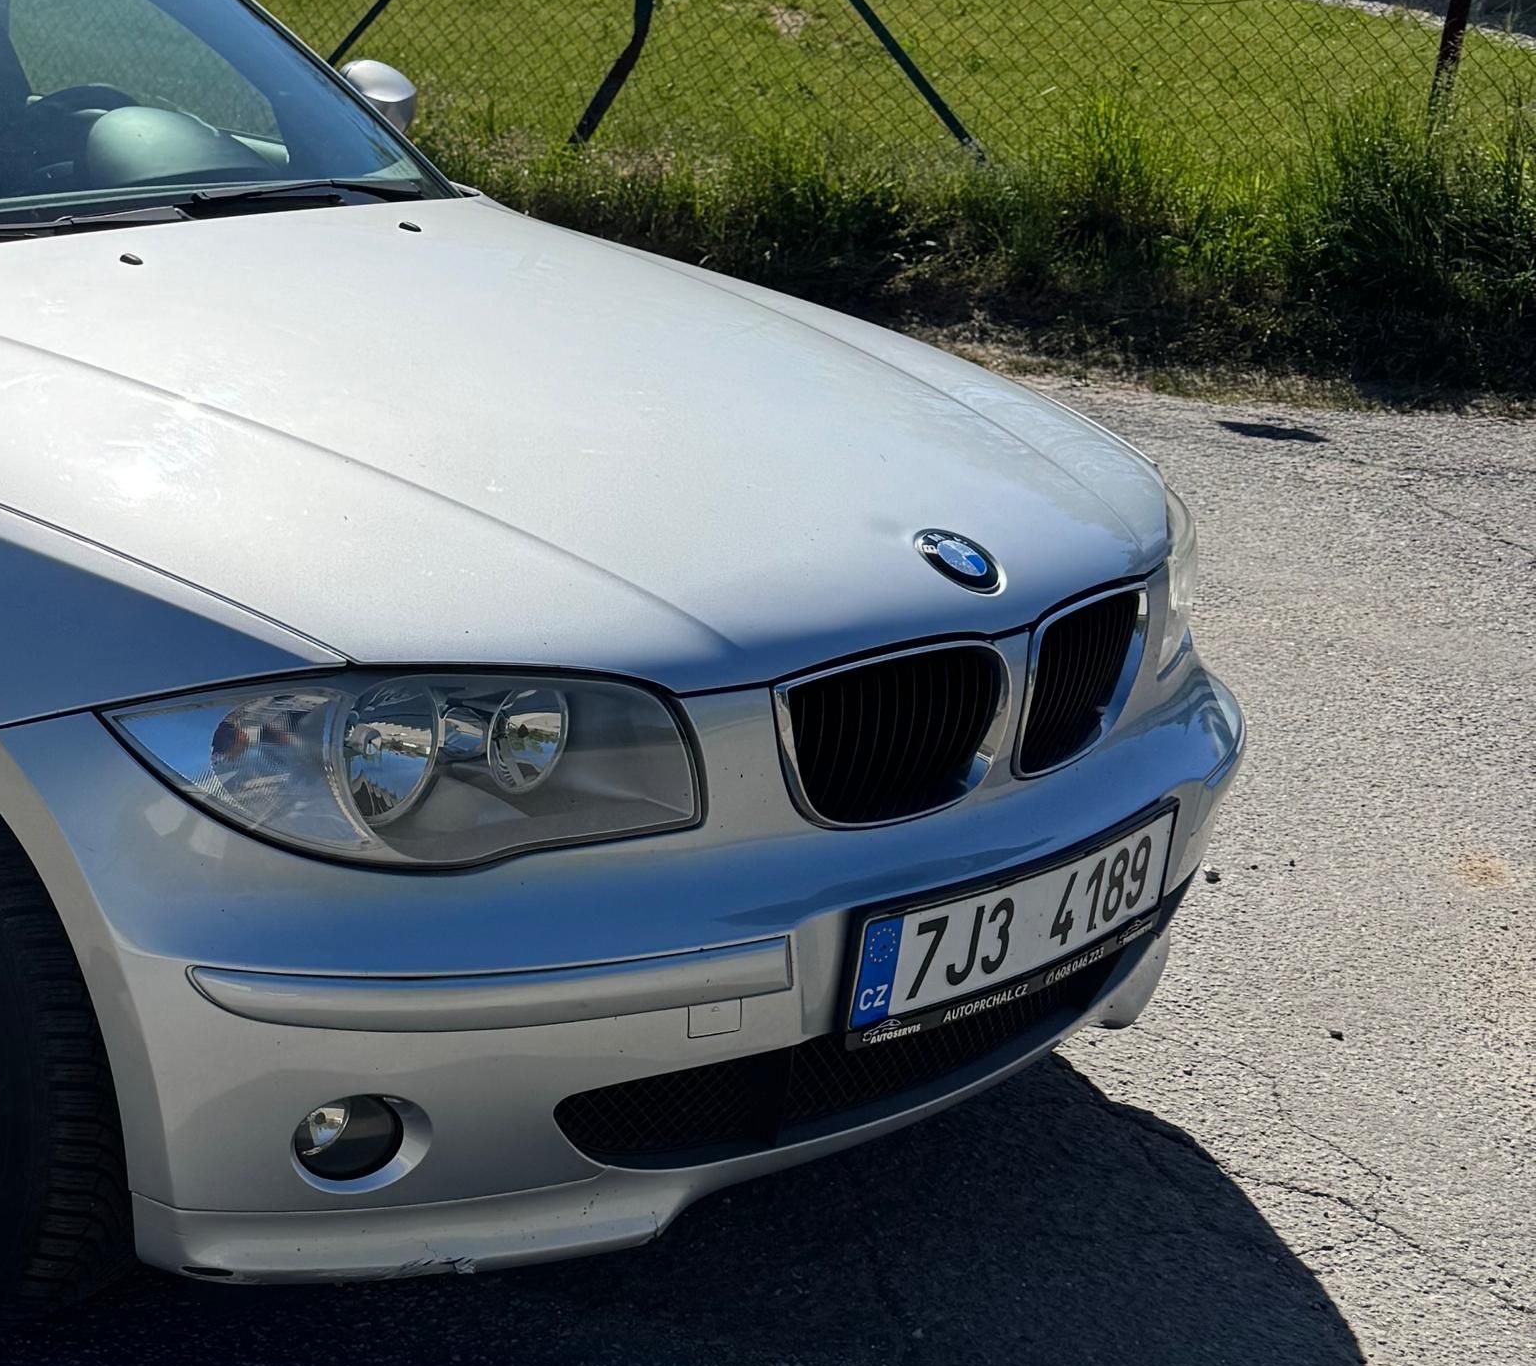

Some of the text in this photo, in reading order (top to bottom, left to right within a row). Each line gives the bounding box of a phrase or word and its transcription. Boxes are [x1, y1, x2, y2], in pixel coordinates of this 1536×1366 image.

[906, 835, 1152, 1001] 7J3 4189
[859, 983, 888, 1011] CZ
[943, 984, 1029, 1023] AUTOPRCHAL.CZ
[870, 1023, 921, 1044] AUTOSERVIS
